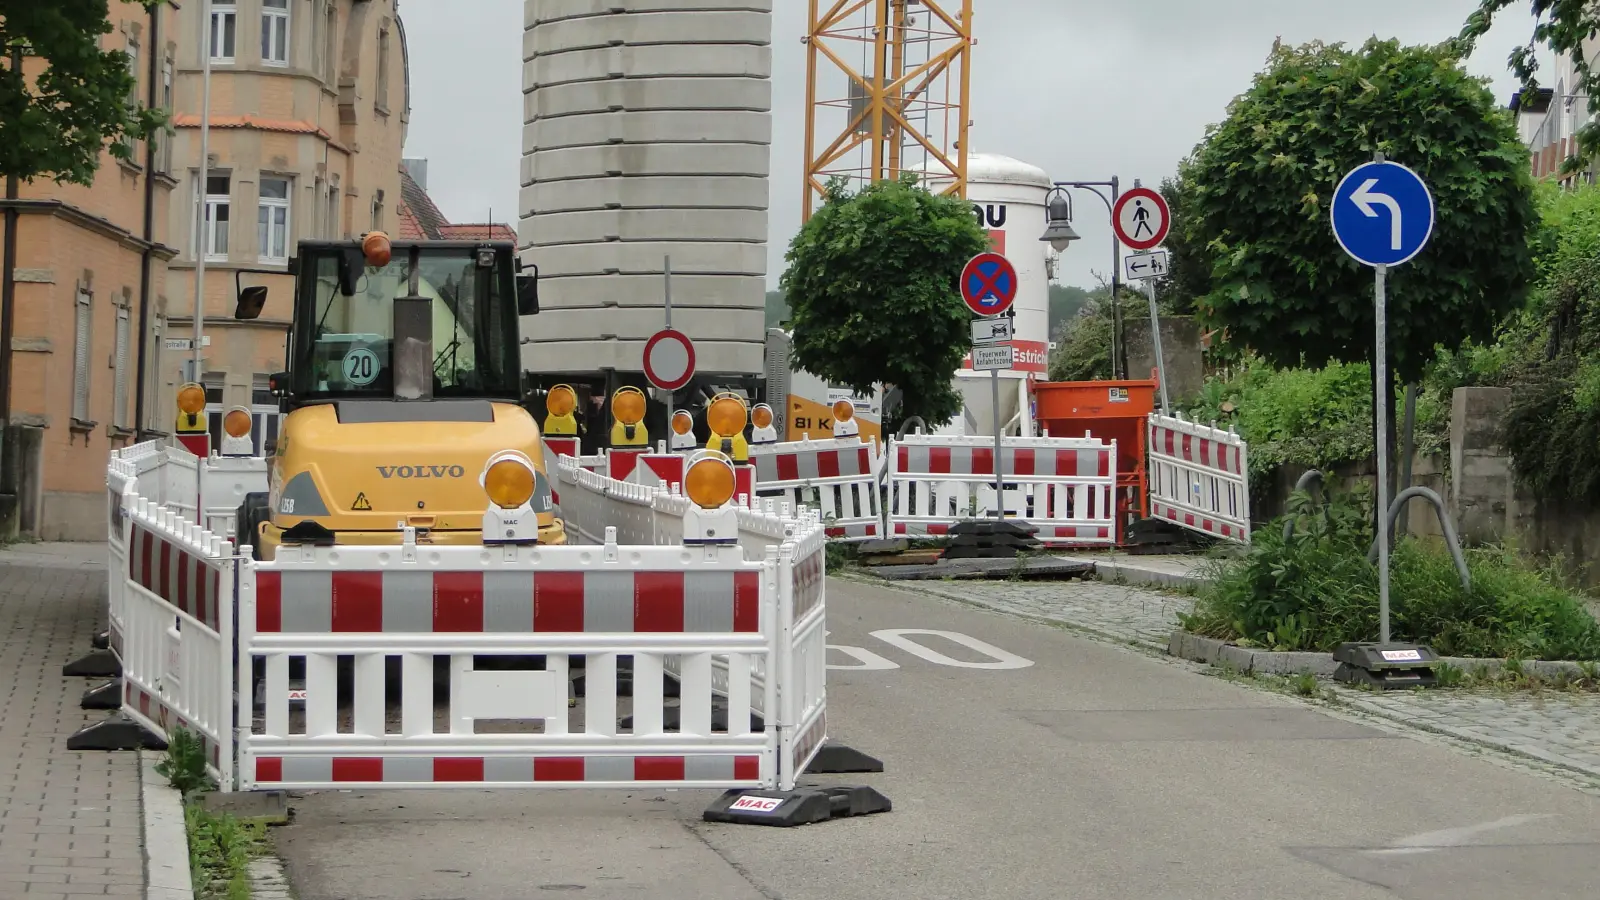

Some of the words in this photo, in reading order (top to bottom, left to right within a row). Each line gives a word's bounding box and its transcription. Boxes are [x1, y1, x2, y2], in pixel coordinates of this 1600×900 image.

[979, 350, 1007, 358] Feuerwehr
[350, 355, 372, 379] 20
[795, 417, 811, 429] 81
[376, 465, 465, 479] VOLVO
[1384, 651, 1418, 659] MAC
[735, 799, 777, 809] MAC
